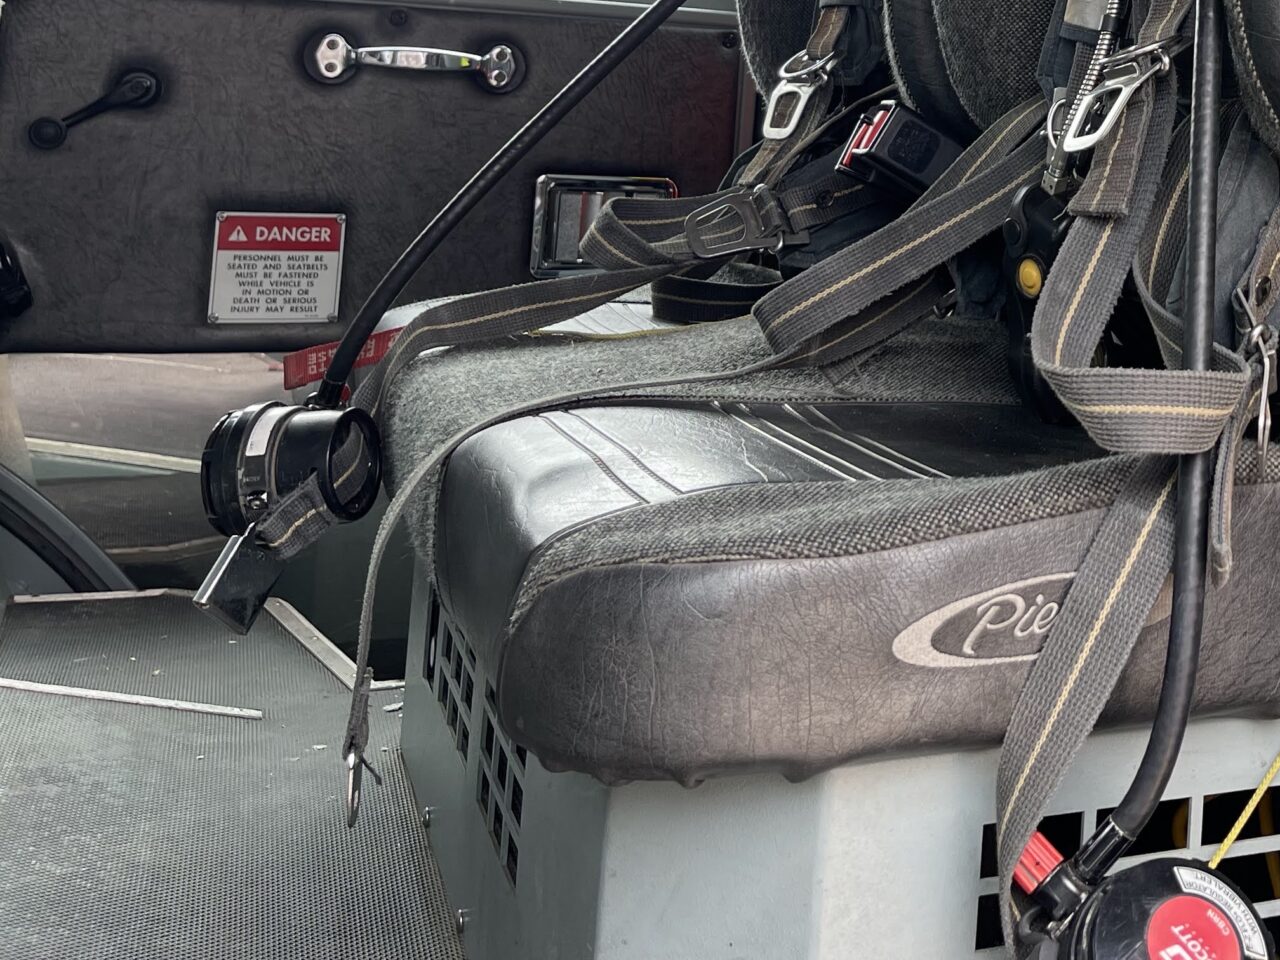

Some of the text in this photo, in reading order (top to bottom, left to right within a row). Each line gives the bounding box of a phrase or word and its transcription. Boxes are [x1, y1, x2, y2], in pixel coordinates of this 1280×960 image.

[256, 226, 331, 242] DANGER
[962, 593, 1061, 655] Pie
[1186, 881, 1233, 912] REGULATOR
[1194, 872, 1257, 935] WITH VIBRALERT
[1207, 909, 1230, 936] CBRN
